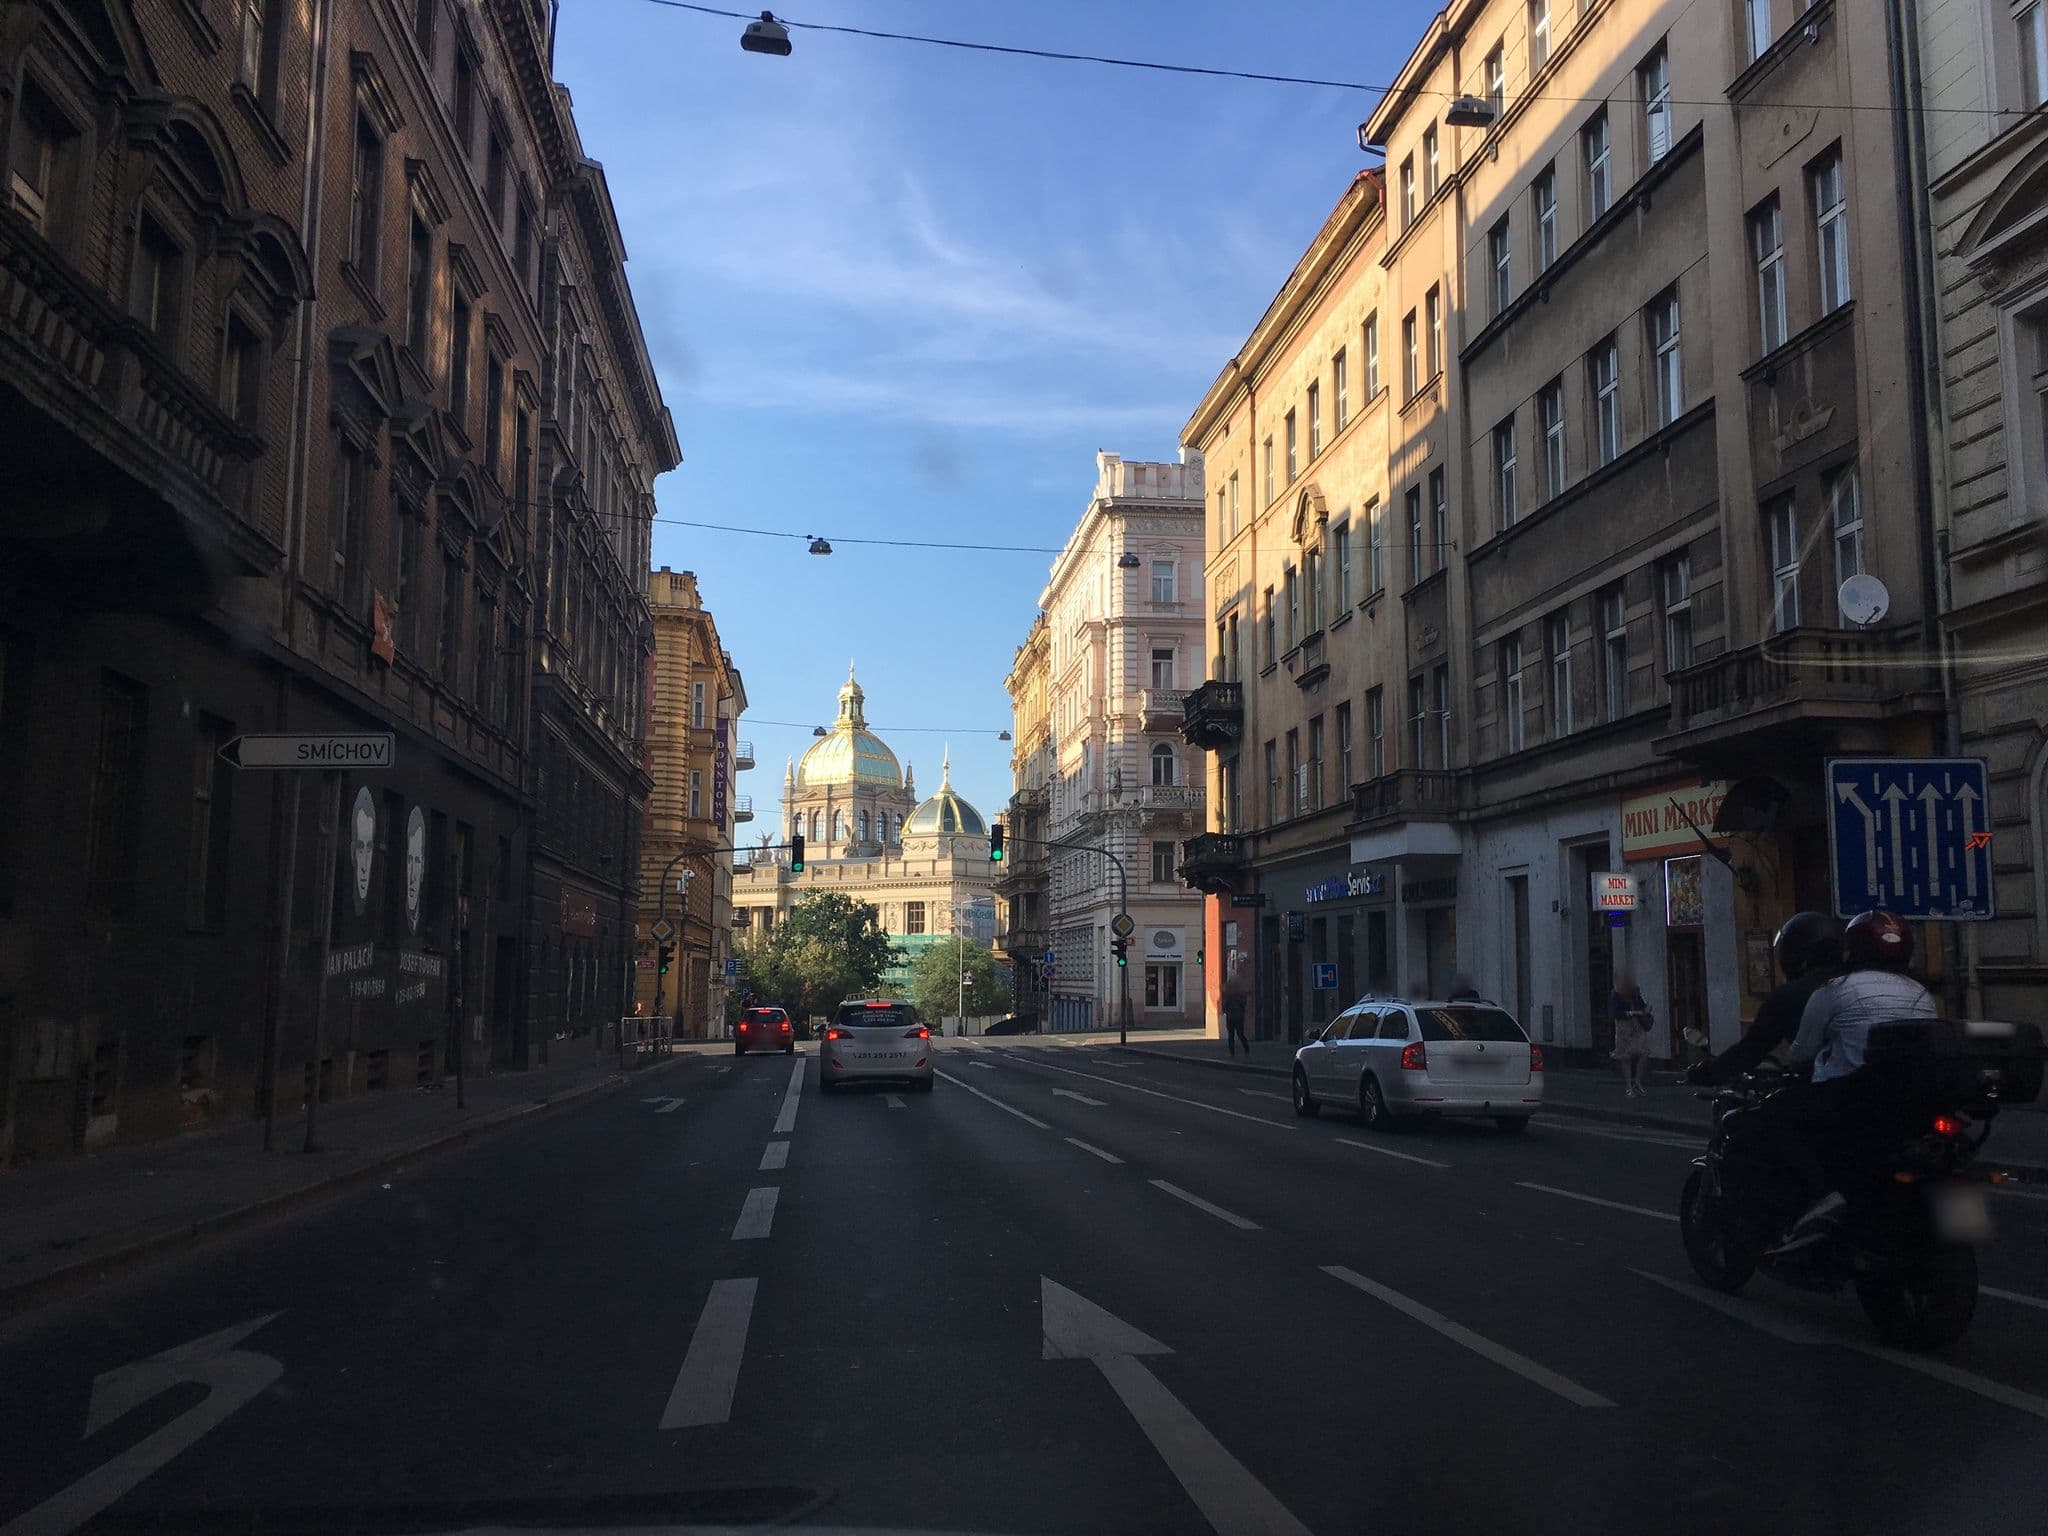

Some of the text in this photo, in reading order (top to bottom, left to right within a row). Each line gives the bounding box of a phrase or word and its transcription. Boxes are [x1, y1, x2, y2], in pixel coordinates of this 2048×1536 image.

[296, 739, 386, 760] SMÍCHOV
[714, 741, 726, 819] DOWNTOWN
[1624, 795, 1725, 839] MINI MARKE
[1607, 878, 1627, 889] MINI
[1600, 894, 1635, 906] MARKET
[343, 943, 375, 972] PALACH
